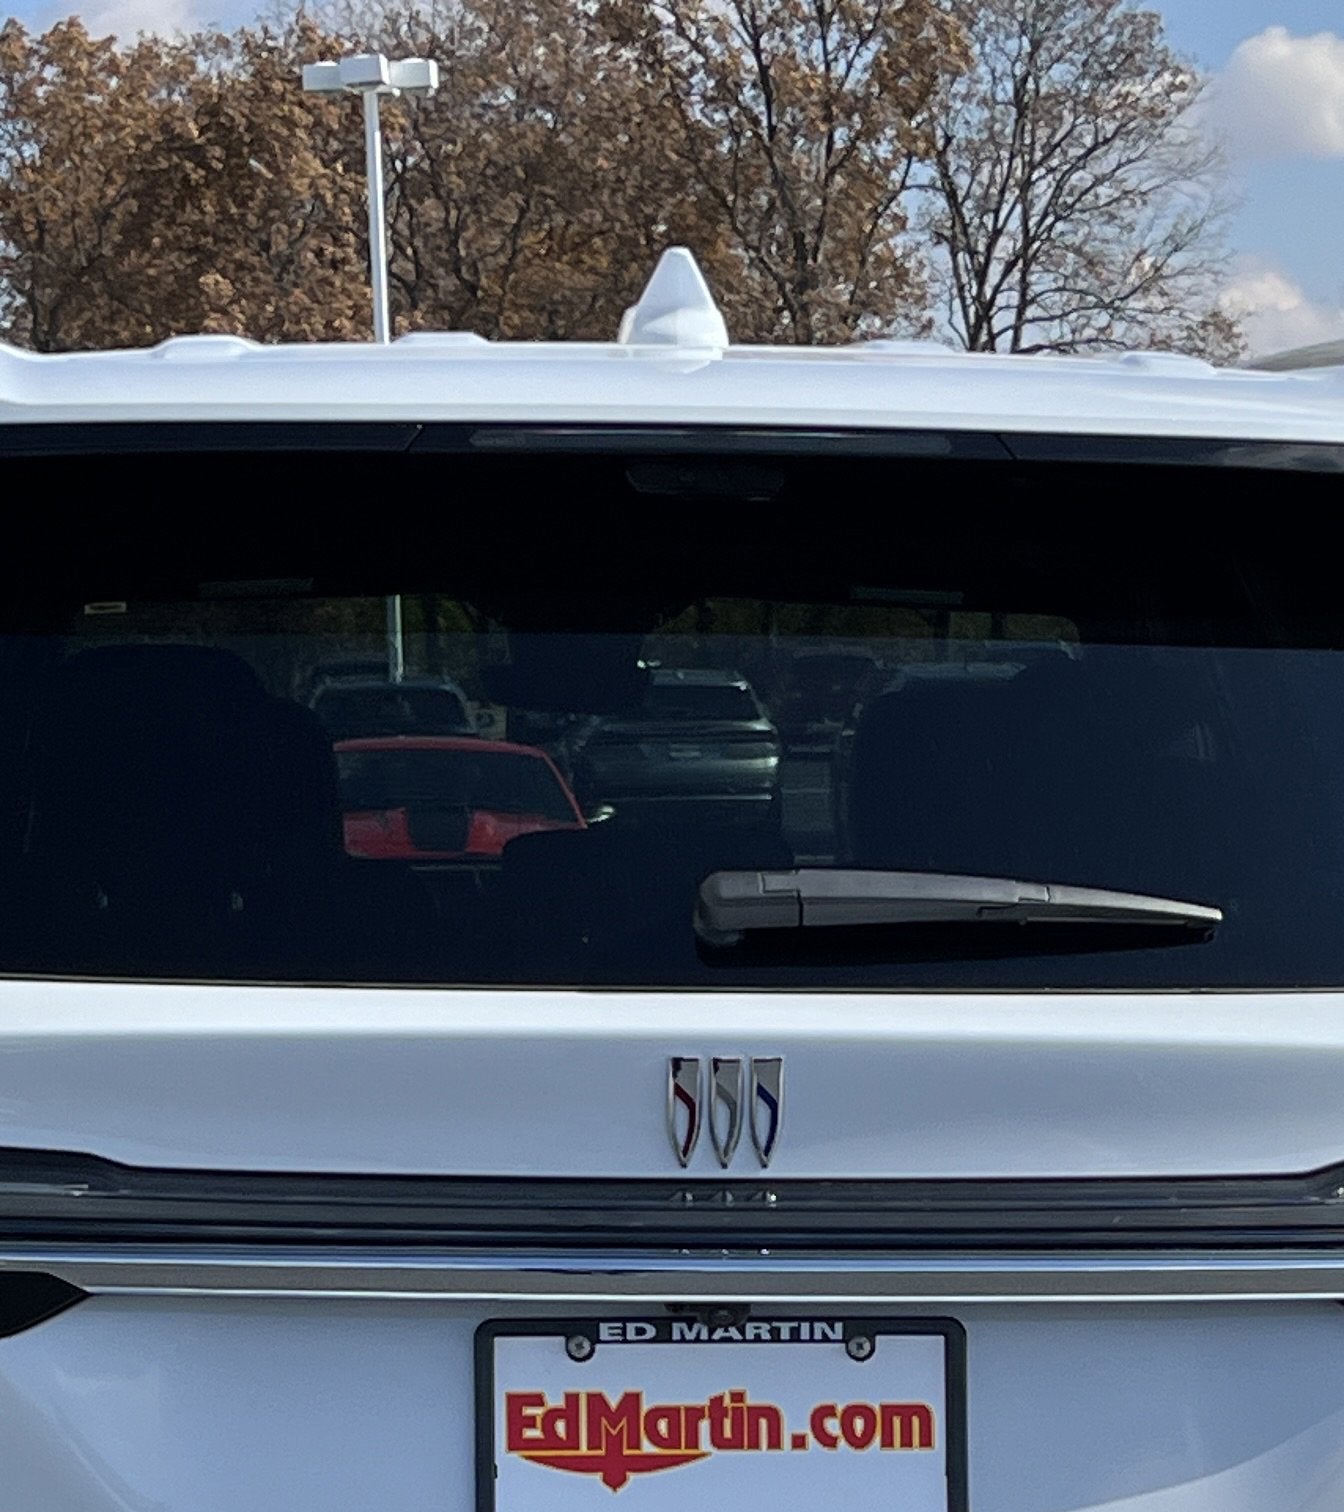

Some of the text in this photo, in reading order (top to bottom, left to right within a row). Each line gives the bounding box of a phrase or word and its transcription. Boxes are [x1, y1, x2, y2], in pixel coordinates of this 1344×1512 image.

[598, 1321, 844, 1342] ED MARTIN
[504, 1388, 936, 1454] EdMartin.com
